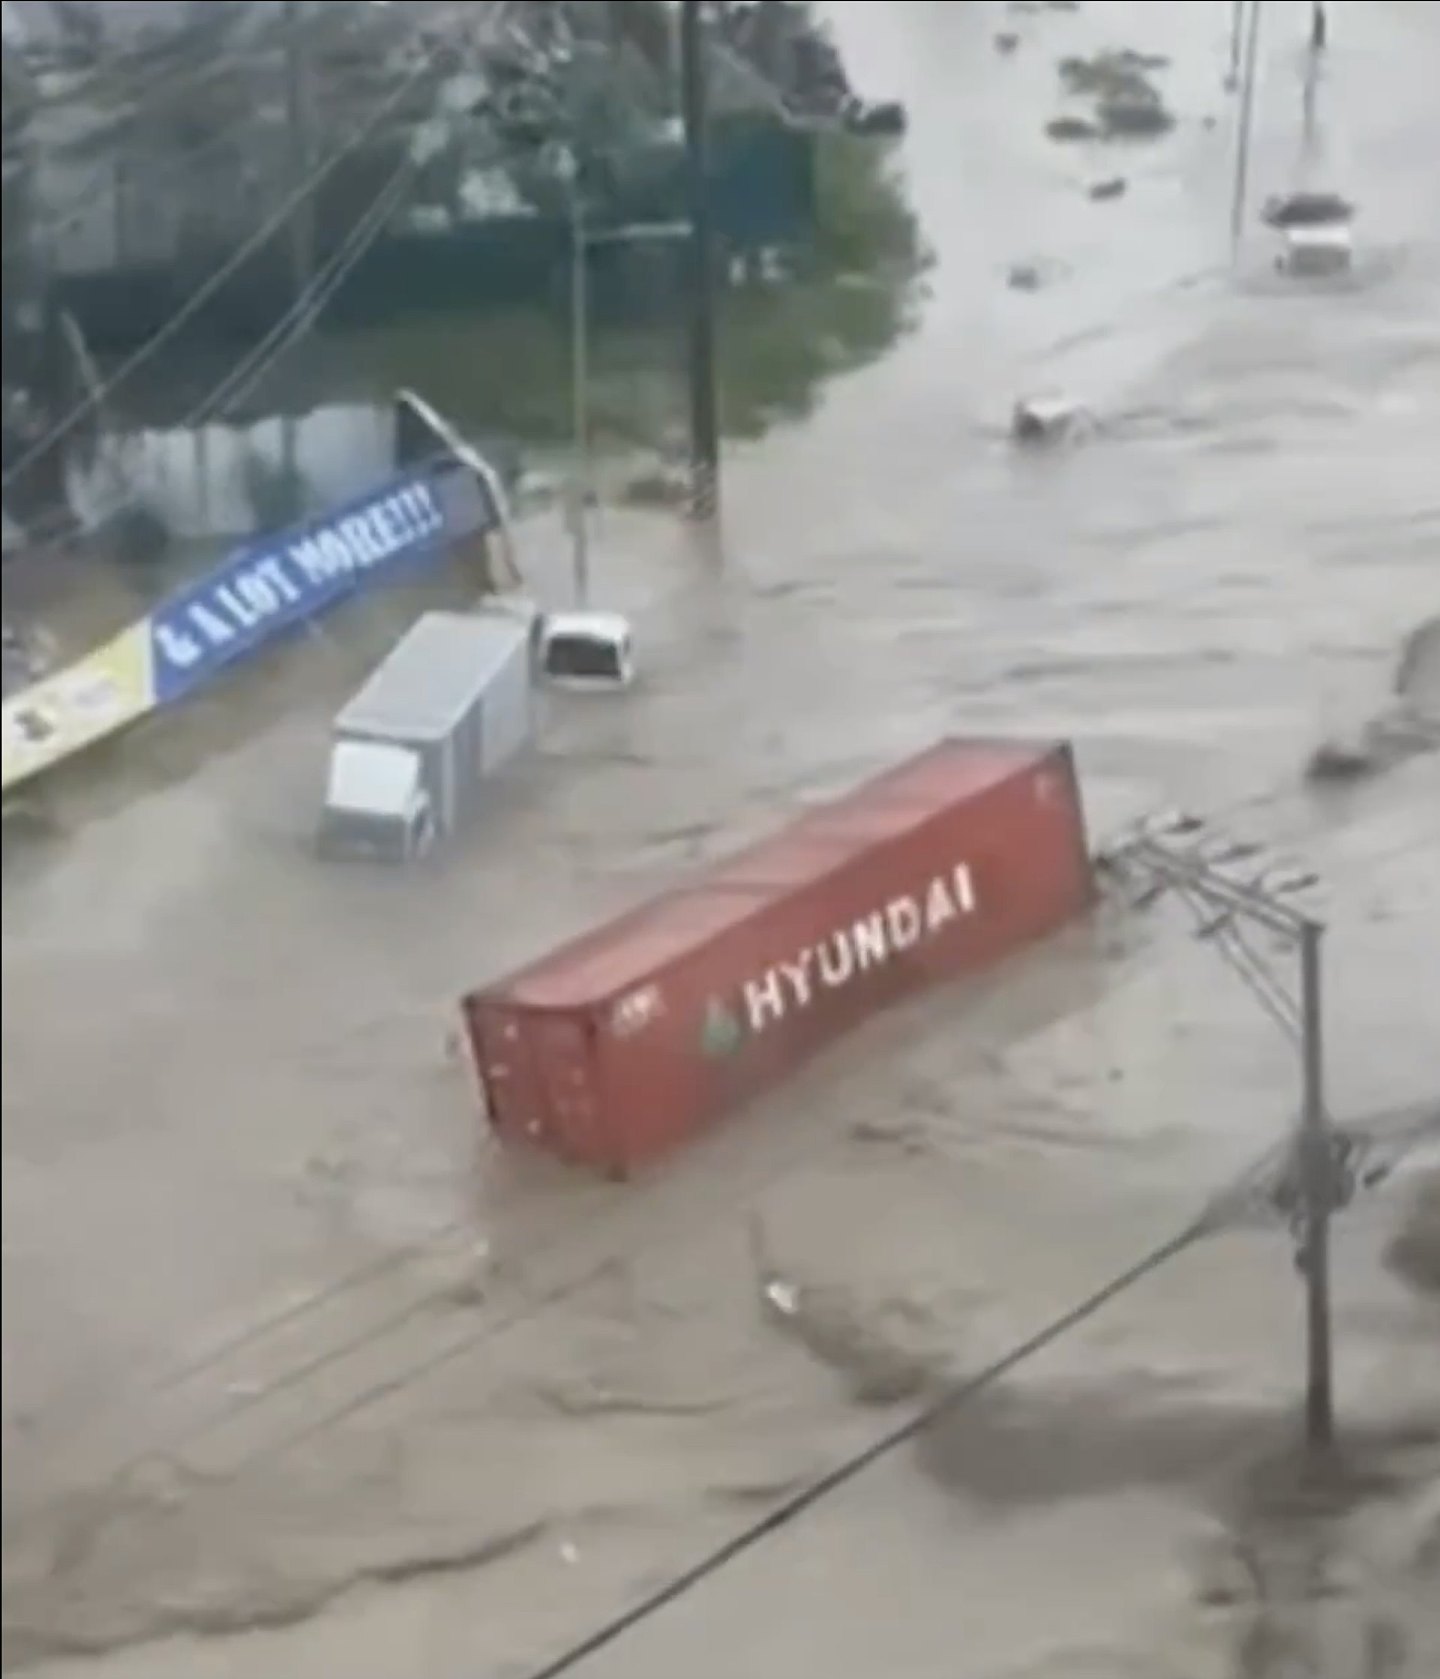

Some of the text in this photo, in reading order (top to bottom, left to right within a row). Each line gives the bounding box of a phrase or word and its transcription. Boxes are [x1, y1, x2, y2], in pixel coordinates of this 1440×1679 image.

[157, 483, 443, 666] & A LOT MORE!!!
[743, 862, 977, 1032] HYUNDAI
